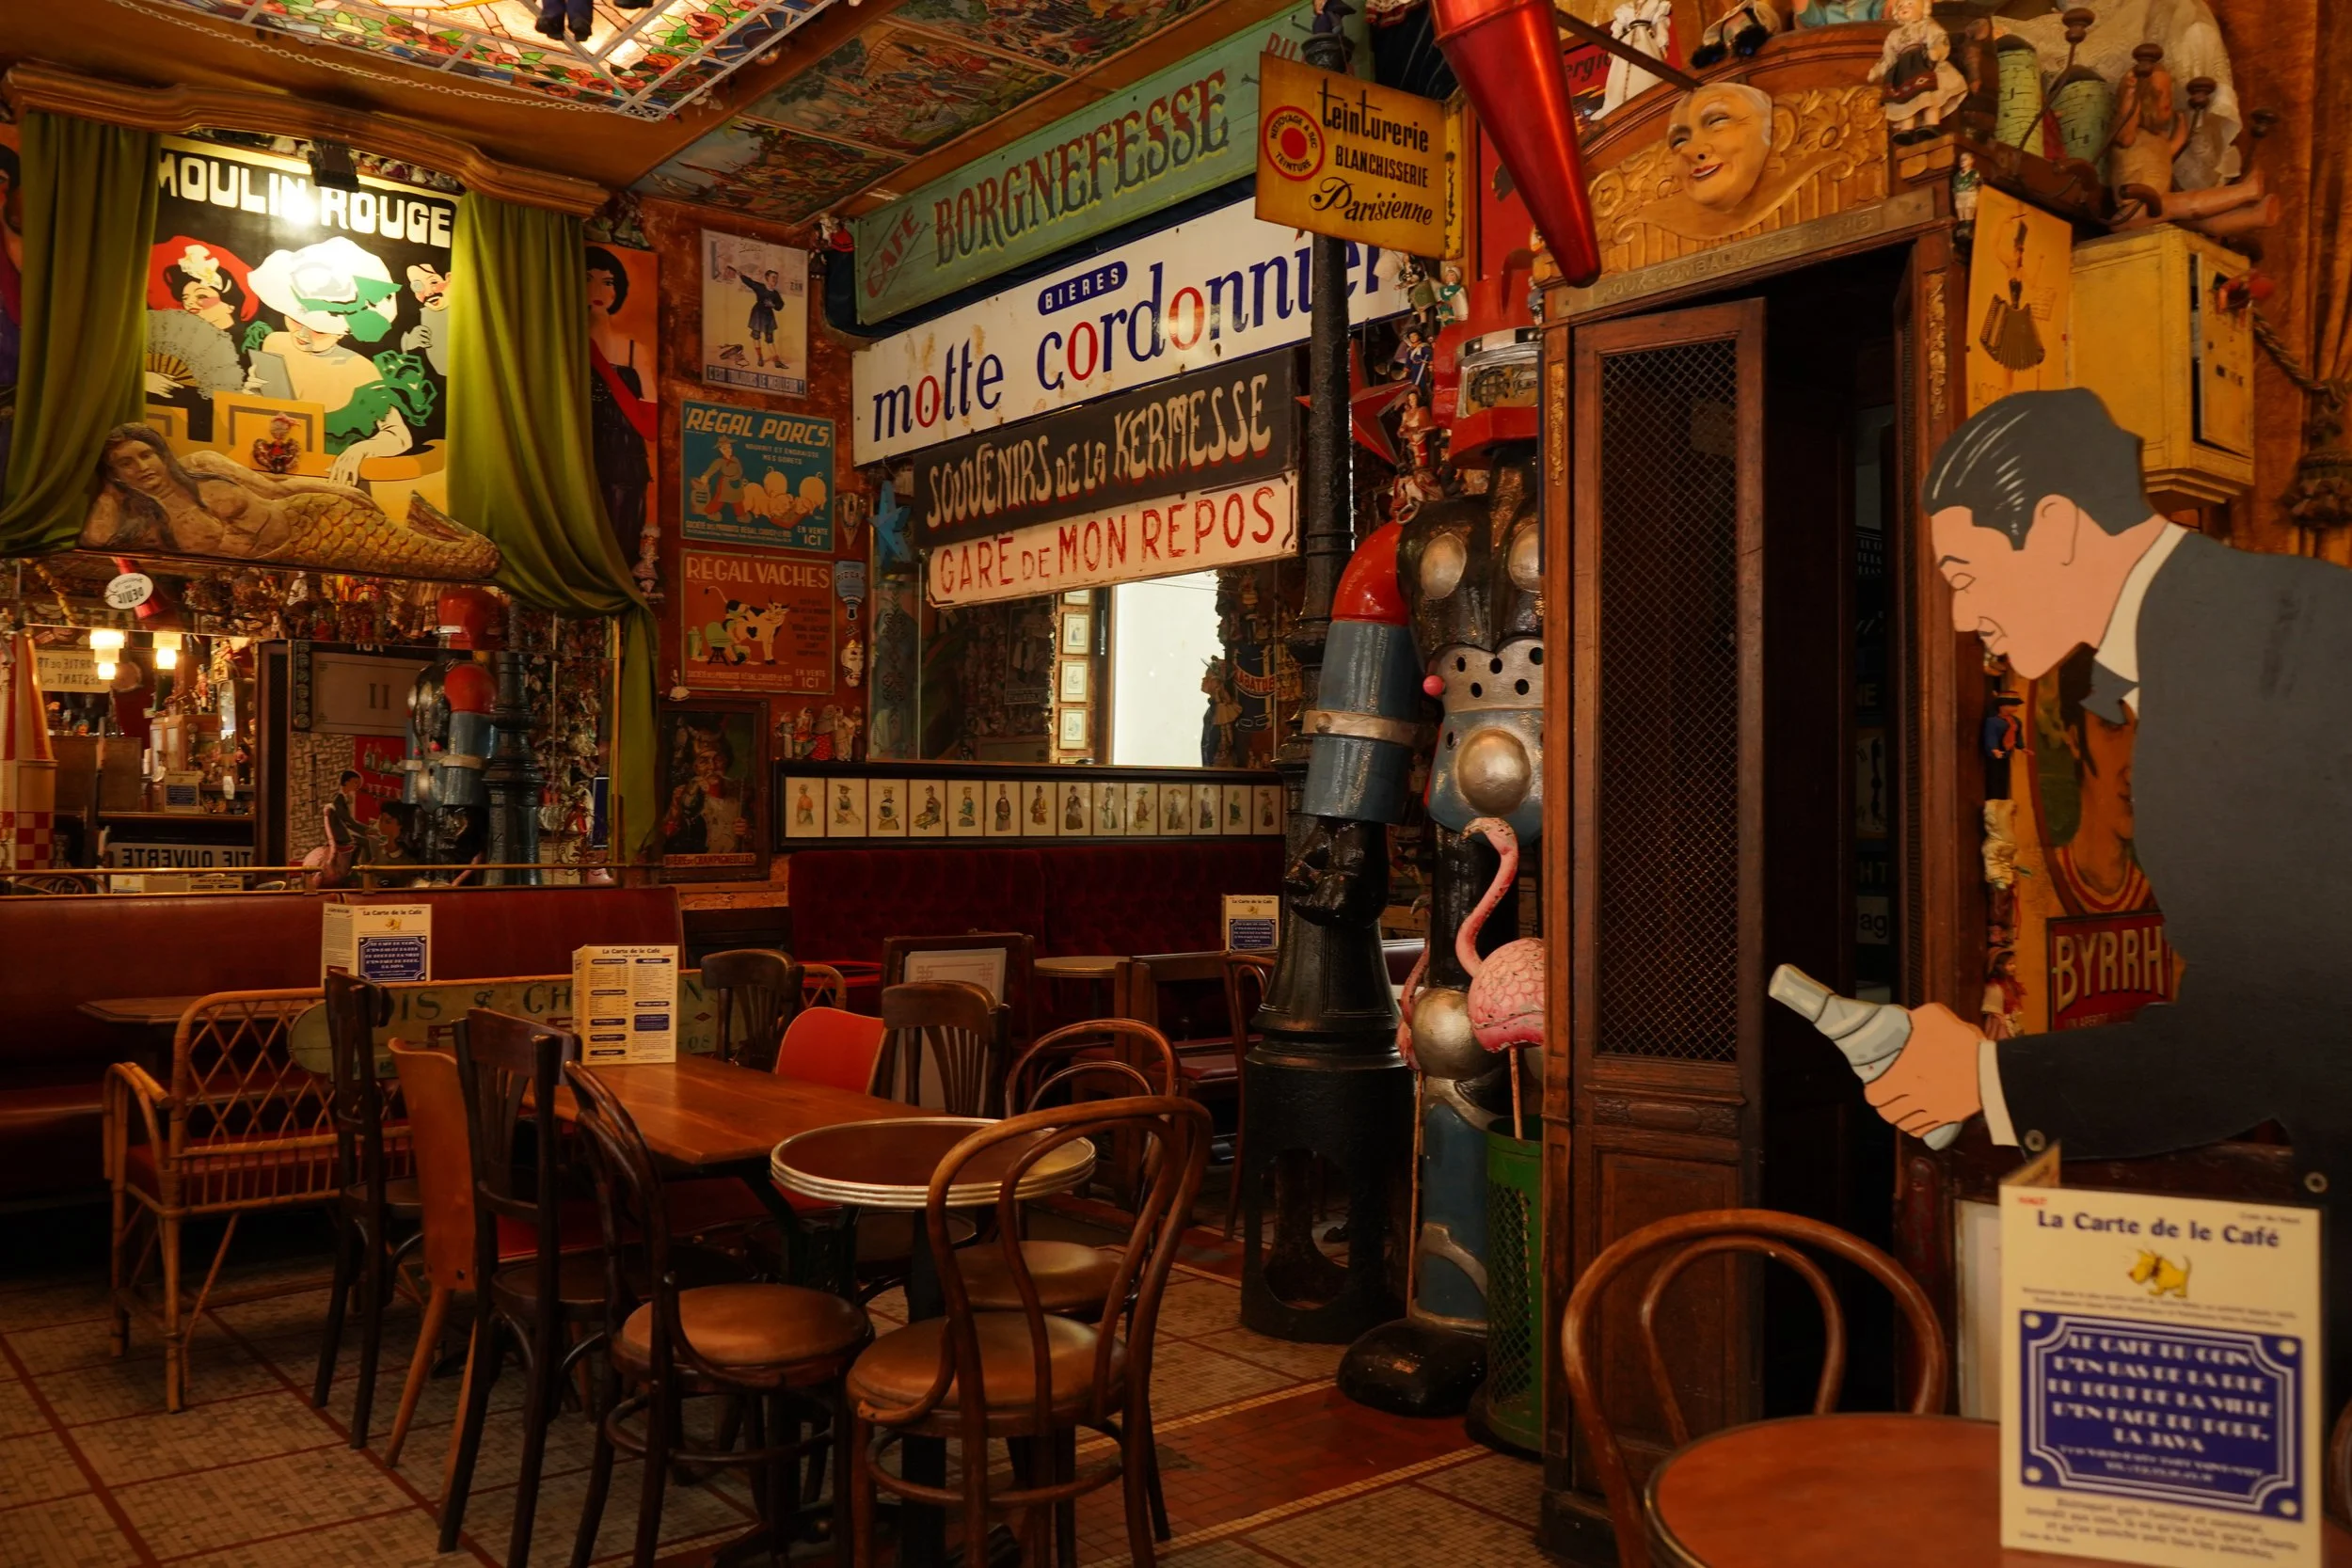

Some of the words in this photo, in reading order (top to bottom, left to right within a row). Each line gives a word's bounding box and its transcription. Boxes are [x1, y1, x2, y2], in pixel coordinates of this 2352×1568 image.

[1317, 77, 1429, 152] teinturerie
[934, 68, 1231, 269] BORGNEFESSE
[1276, 151, 1311, 172] TEINTURE
[1336, 145, 1429, 187] BLANCHISSERIE
[320, 186, 452, 248] ROUGE
[1310, 176, 1433, 226] Parisienne
[1044, 268, 1120, 310] BIÈRES
[874, 339, 1004, 442] motte
[927, 435, 1052, 530] SOUVENIRS
[1083, 438, 1106, 491] LA
[1112, 373, 1273, 483] KERMESSE
[797, 525, 806, 533] EN
[808, 527, 828, 535] VENTE
[804, 534, 821, 546] ICI
[686, 557, 754, 583] RÉGAL
[755, 562, 830, 589] VACHES
[940, 536, 1014, 594] GARE
[1022, 547, 1052, 580] DE
[1058, 514, 1127, 575] MON
[802, 676, 819, 688] ICI
[2054, 926, 2165, 1013] BYRRH
[2038, 1210, 2063, 1228] La
[2074, 1212, 2139, 1234] Carte
[2152, 1217, 2179, 1238] de
[2190, 1220, 2212, 1241] le
[2223, 1225, 2280, 1247] Café
